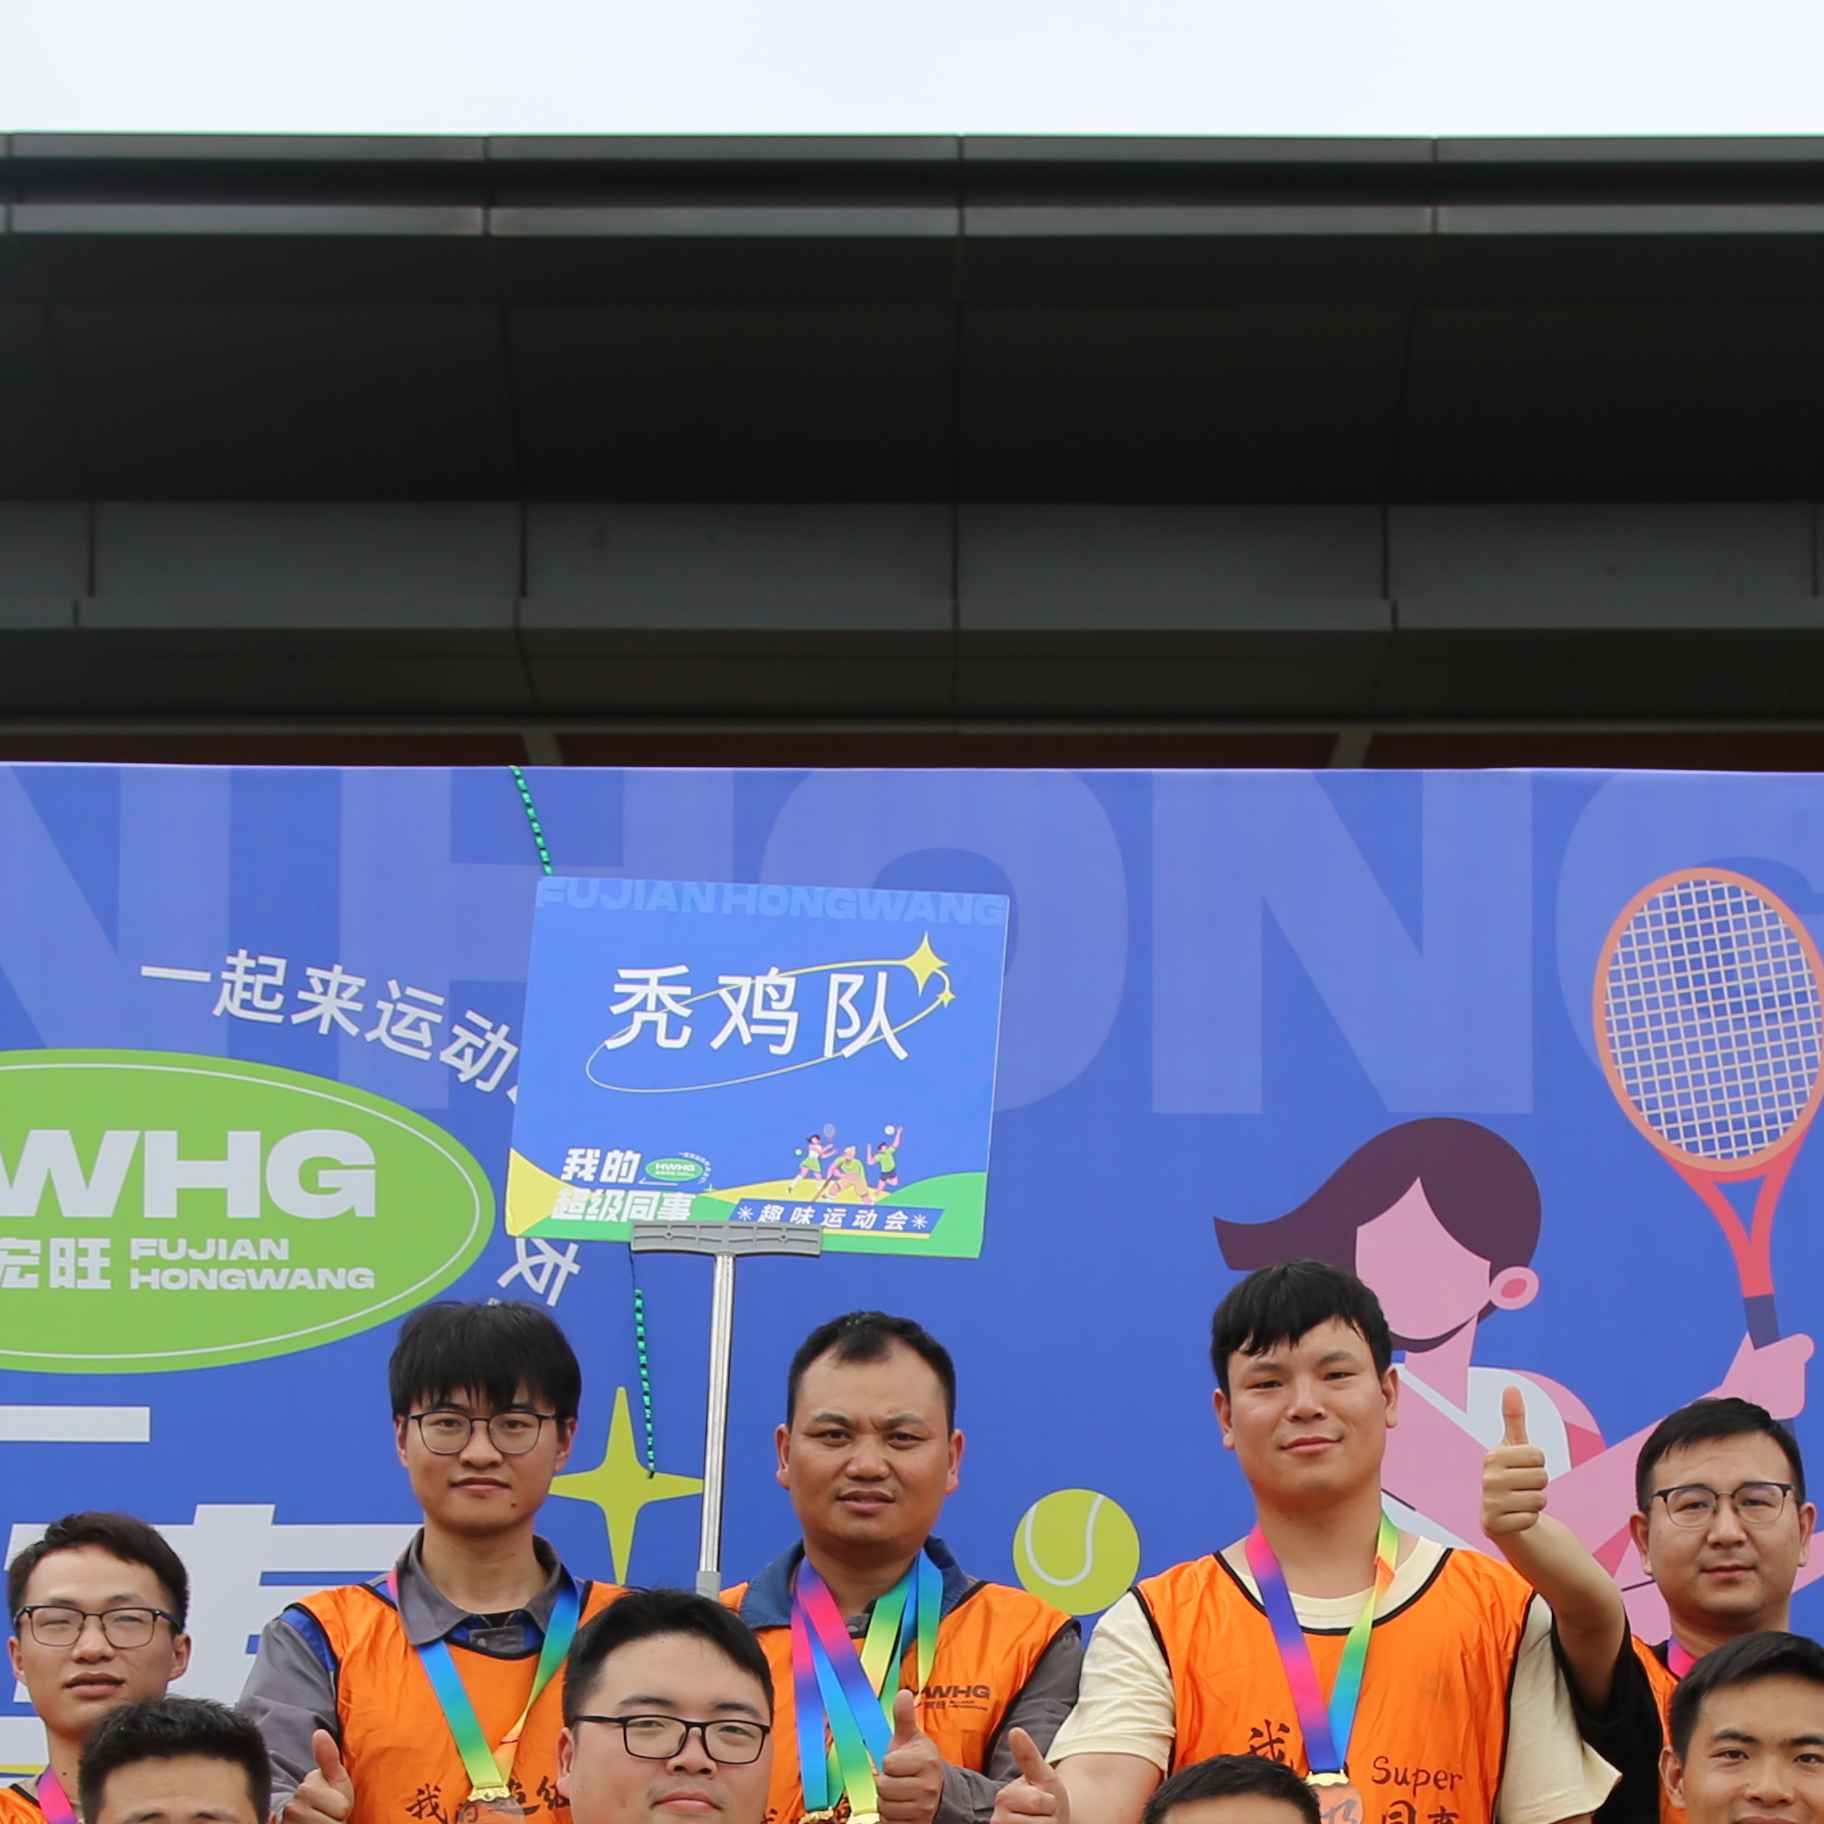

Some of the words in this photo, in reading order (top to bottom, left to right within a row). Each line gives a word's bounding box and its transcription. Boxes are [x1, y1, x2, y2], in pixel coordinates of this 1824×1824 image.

[604, 964, 909, 1061] 秃鸡队
[560, 1147, 642, 1185] 我的
[549, 1188, 697, 1223] 超级同事
[757, 1203, 912, 1233] 趣味运动会
[129, 1237, 290, 1261] FUJIAN
[129, 1266, 376, 1290] HONGWANG
[907, 1685, 991, 1700] WHG
[1370, 1755, 1464, 1799] Super
